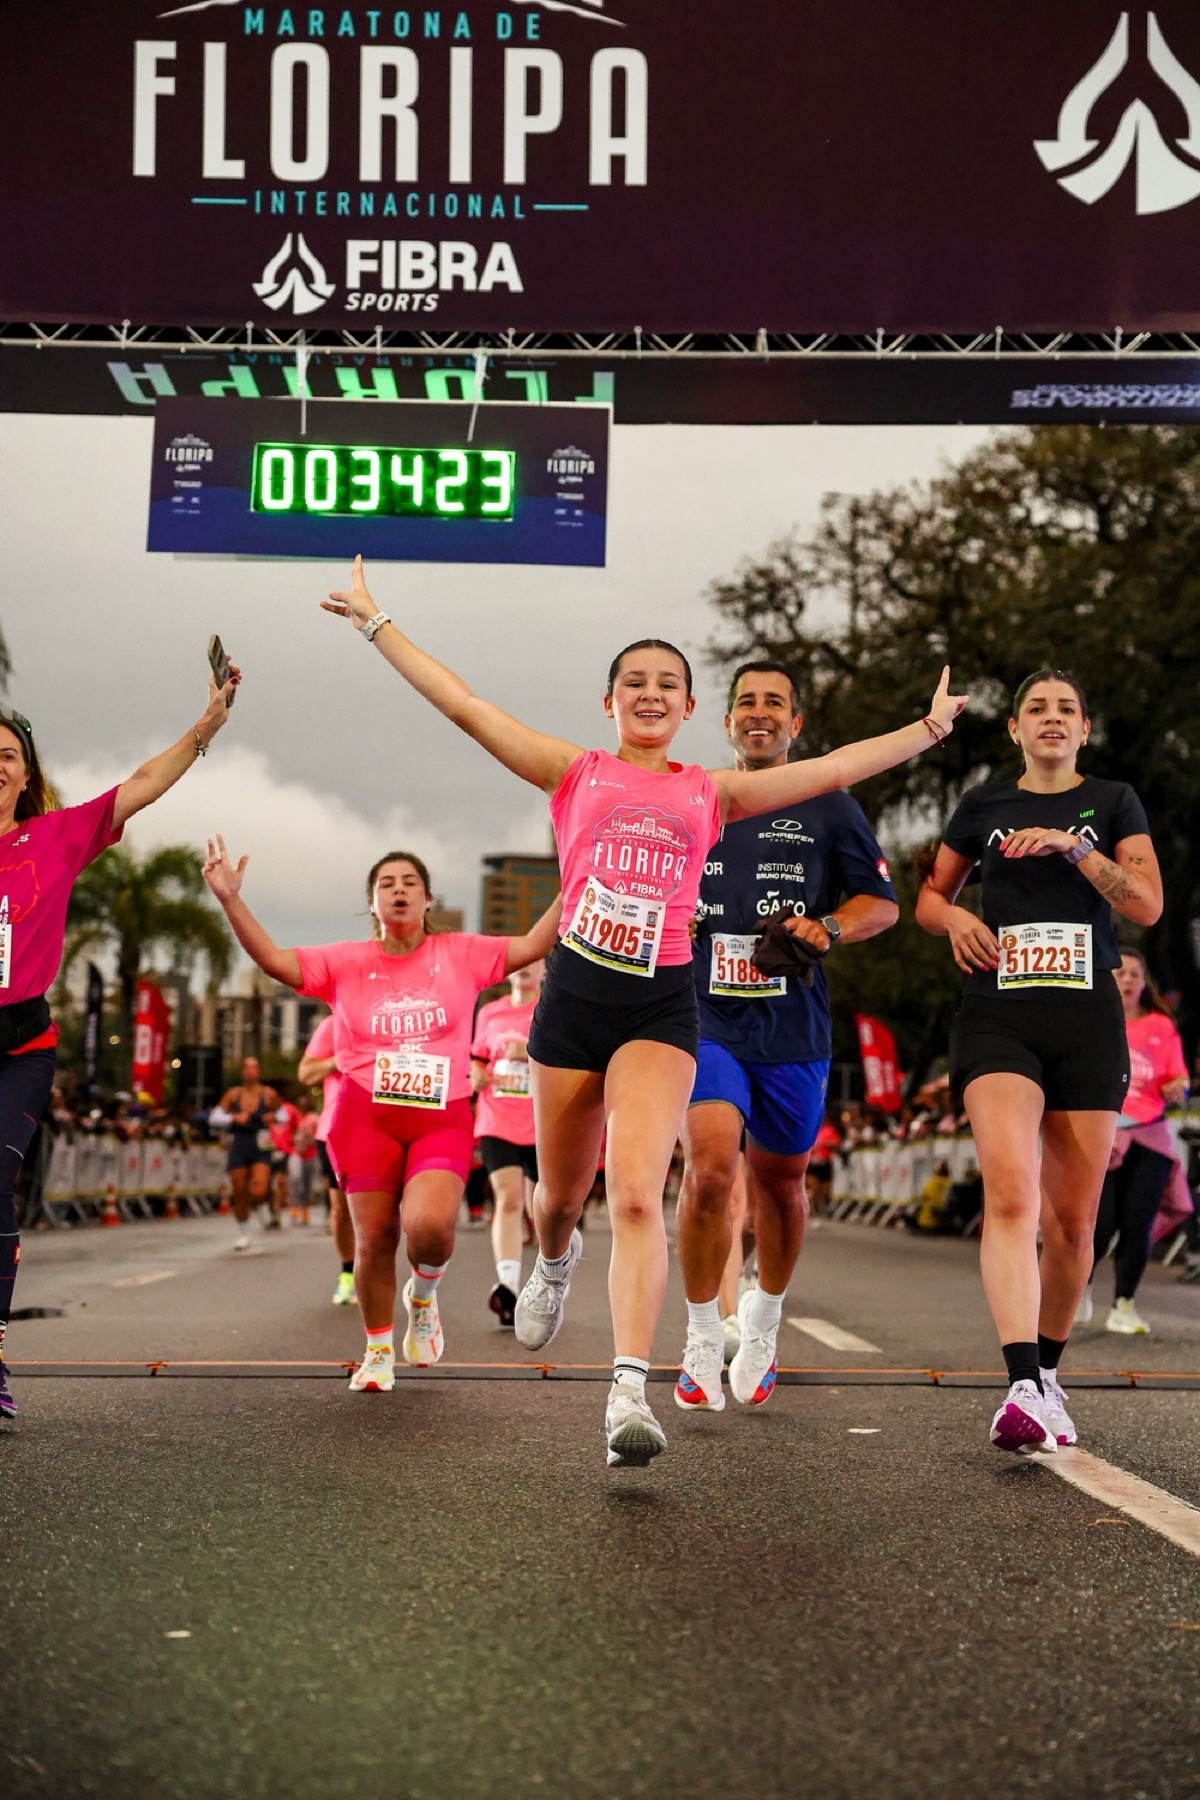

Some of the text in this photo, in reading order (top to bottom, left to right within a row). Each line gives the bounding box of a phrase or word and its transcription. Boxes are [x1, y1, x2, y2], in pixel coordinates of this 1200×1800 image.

[243, 10, 541, 40] MARATONA DE
[132, 40, 649, 186] FLORIPA
[254, 190, 526, 219] INTERNACIONAL
[345, 238, 524, 292] FIBRA
[344, 292, 440, 312] SPORTS
[261, 448, 511, 512] 003423
[757, 832, 815, 844] SCHAEFER
[594, 841, 687, 882] FLORIPA
[630, 882, 663, 899] FIBRA
[577, 905, 641, 956] 51905
[717, 957, 769, 983] 5188
[1006, 946, 1071, 973] 51223
[371, 1007, 447, 1035] FLORIPA
[381, 1071, 432, 1095] 52248
